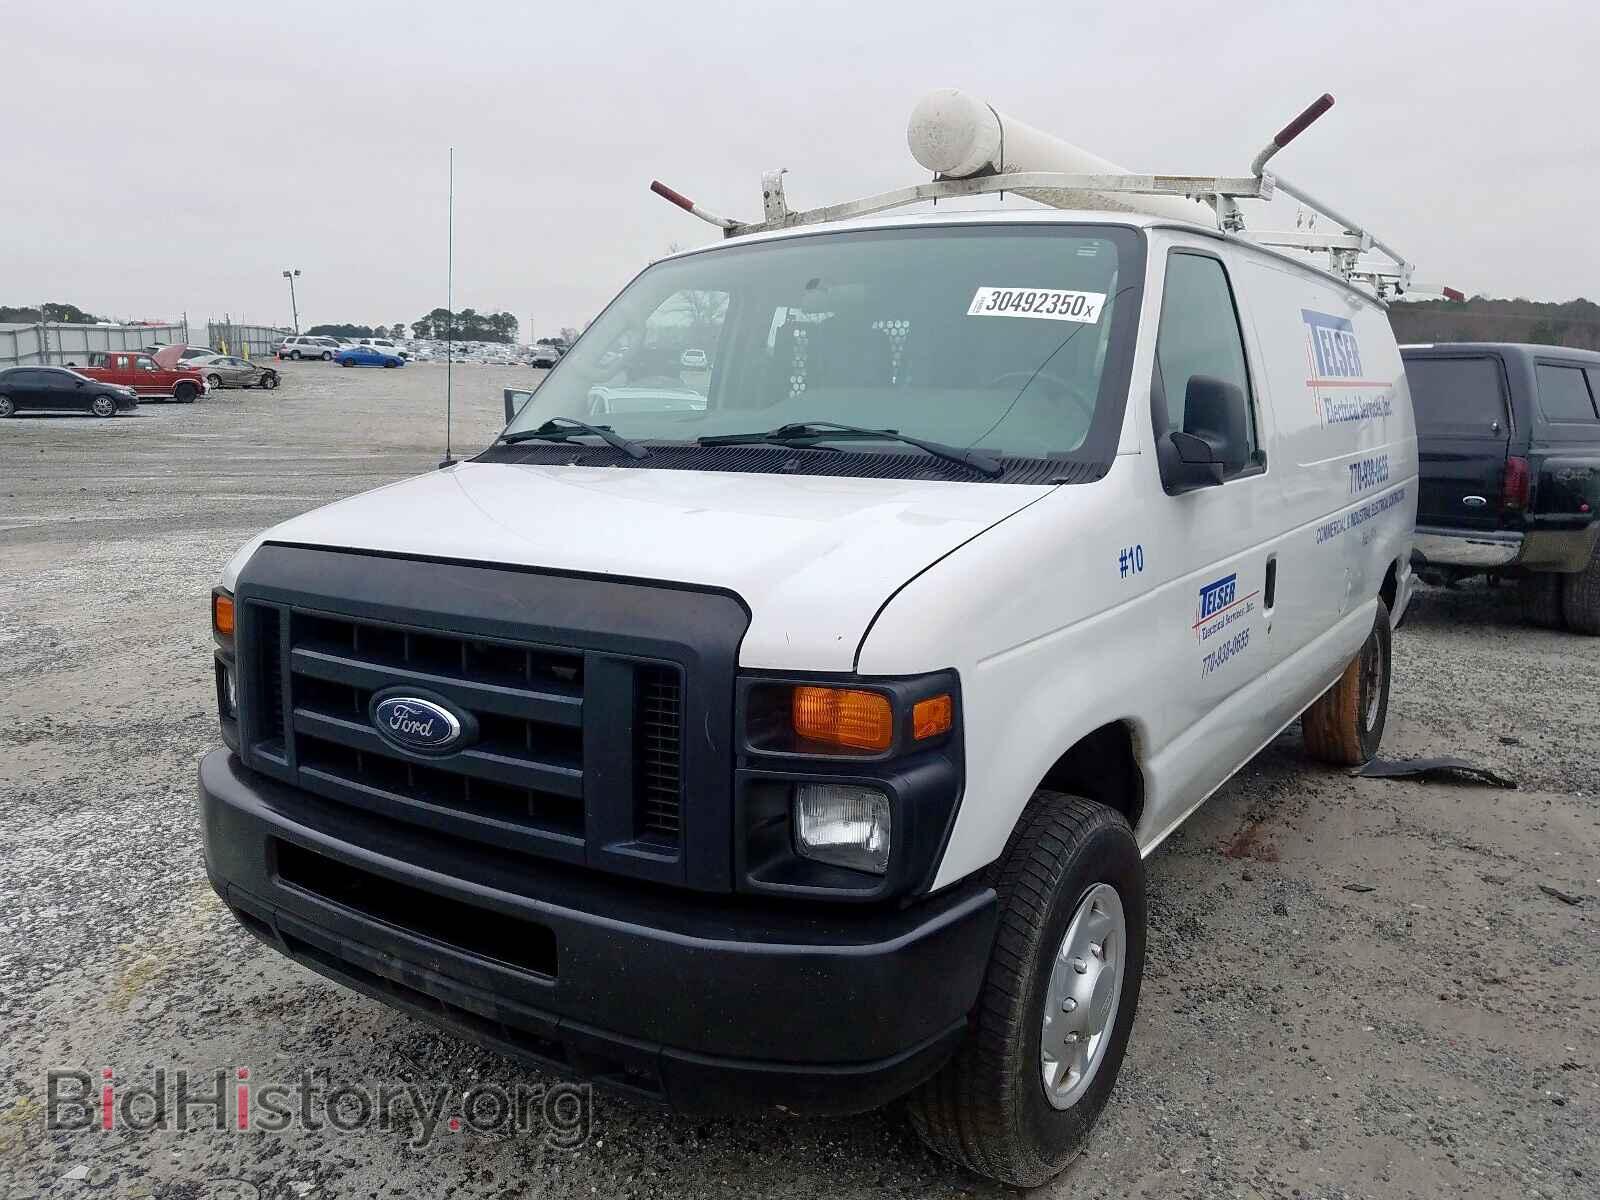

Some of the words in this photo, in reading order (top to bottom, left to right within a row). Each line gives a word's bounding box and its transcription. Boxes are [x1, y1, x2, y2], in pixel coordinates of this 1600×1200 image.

[1300, 308, 1364, 377] TELSER
[1324, 396, 1360, 424] Electrical
[1119, 544, 1144, 579] #10
[1200, 572, 1237, 619] TELSER
[1202, 616, 1225, 641] Electrical
[1201, 627, 1250, 680] 770-938-0655
[389, 704, 435, 737] Ford
